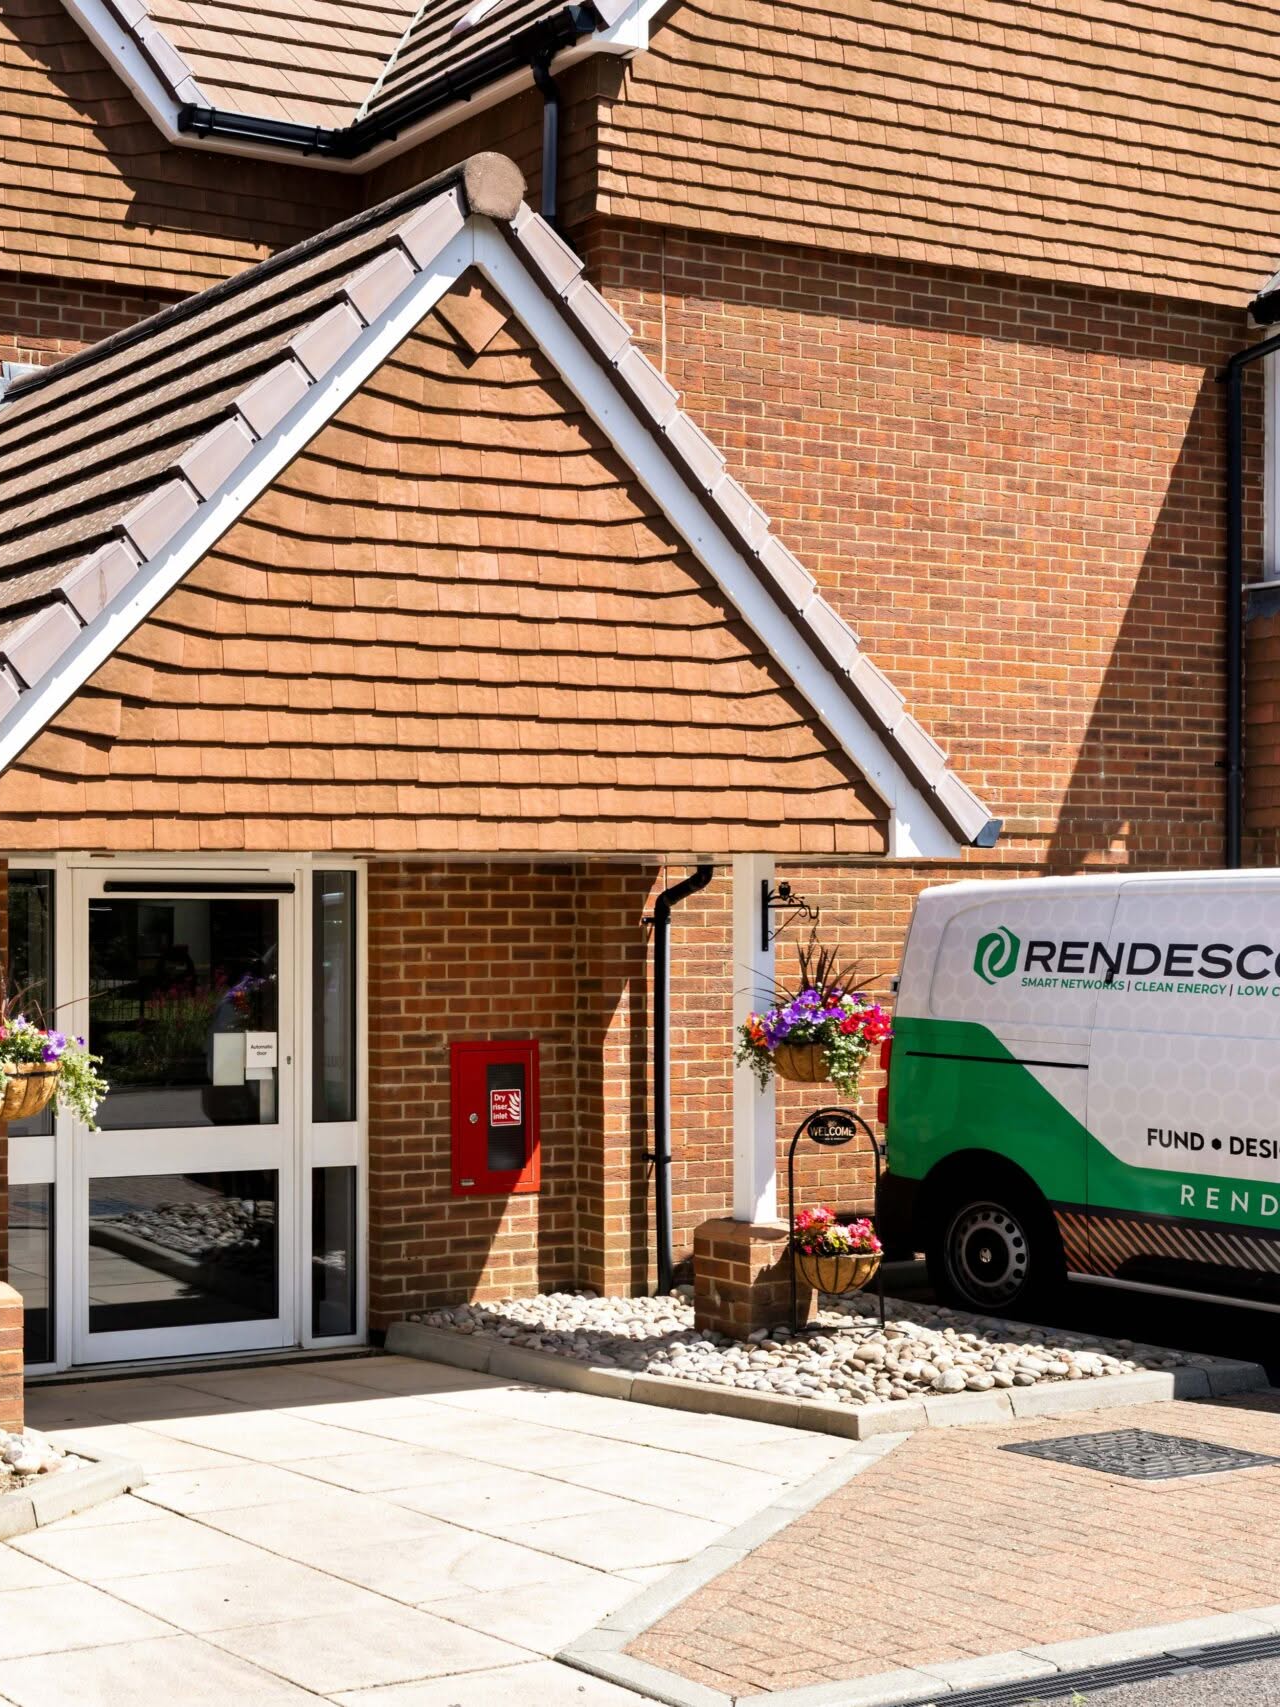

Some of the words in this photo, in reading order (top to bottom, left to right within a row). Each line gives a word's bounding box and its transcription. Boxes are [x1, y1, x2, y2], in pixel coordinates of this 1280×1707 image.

[1023, 939, 1280, 981] RENDESC
[1021, 977, 1059, 988] SMART
[1061, 979, 1125, 991] NETWORKS
[1134, 981, 1174, 993] CLEAN
[1176, 982, 1227, 995] ENERGY
[1237, 985, 1269, 997] LOW
[494, 1093, 506, 1103] Dry
[493, 1112, 508, 1120] inlet
[810, 1126, 855, 1137] WELCOME
[1147, 1128, 1205, 1151] FUND
[1229, 1135, 1280, 1160] DESI
